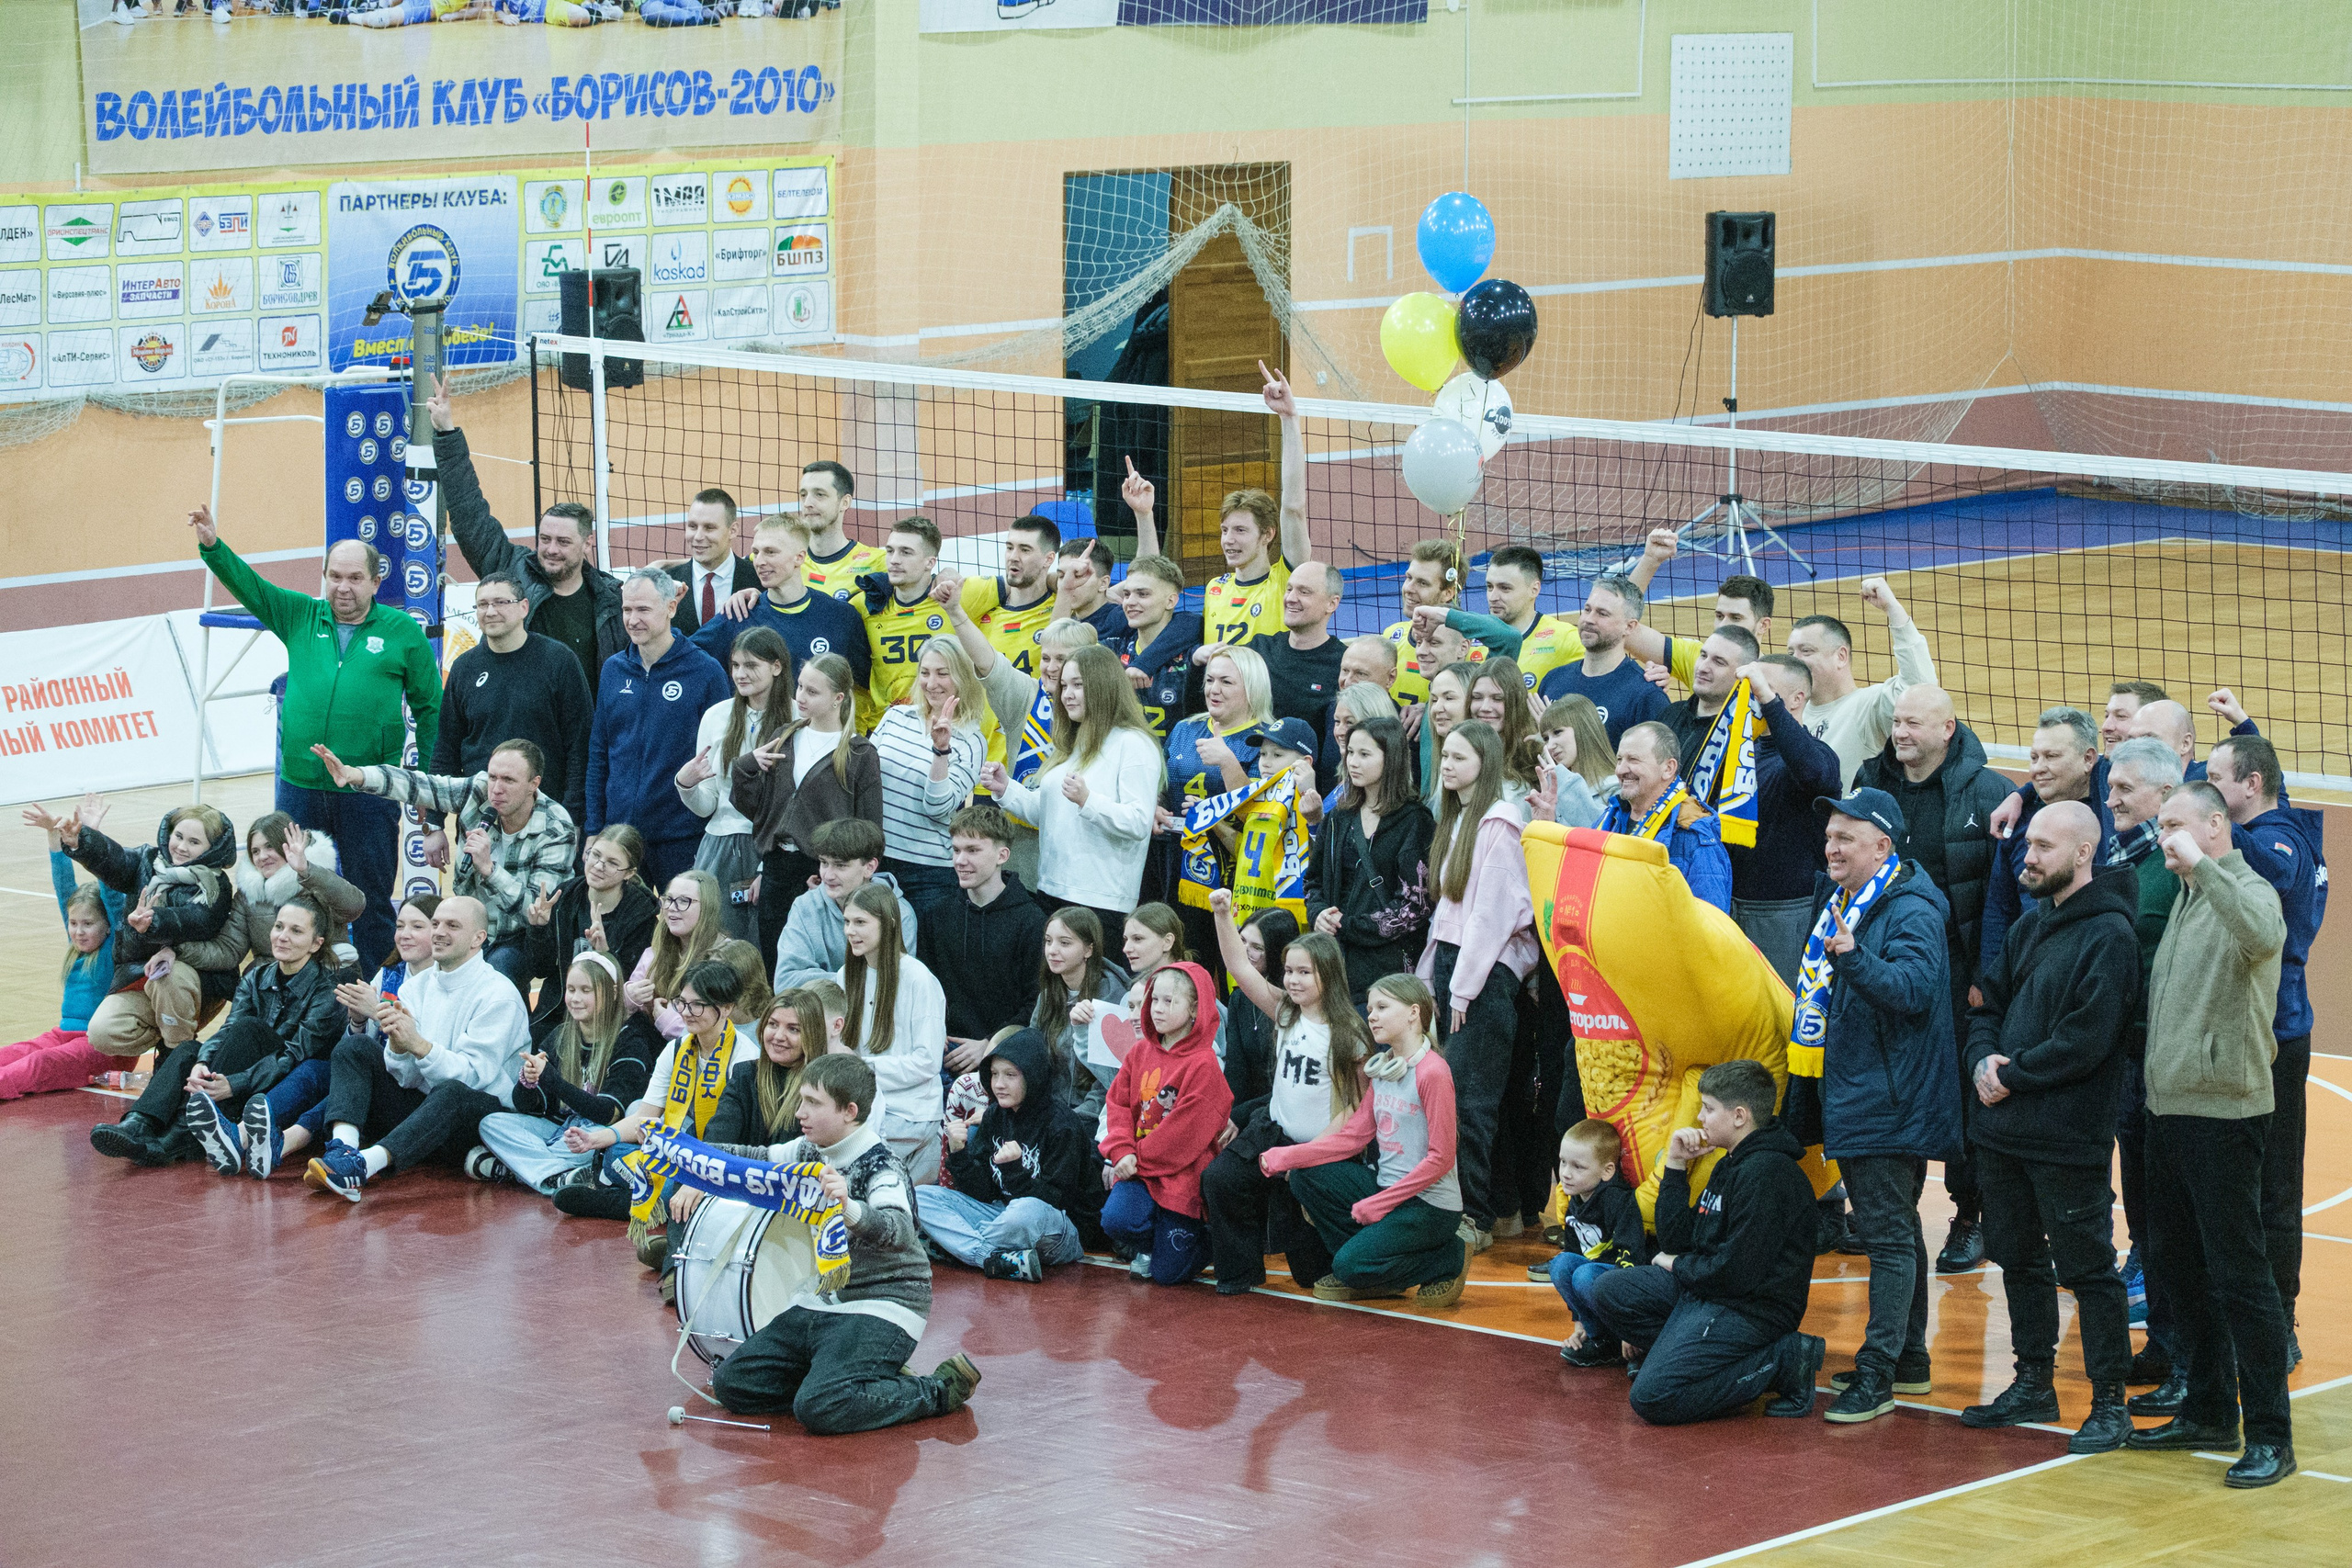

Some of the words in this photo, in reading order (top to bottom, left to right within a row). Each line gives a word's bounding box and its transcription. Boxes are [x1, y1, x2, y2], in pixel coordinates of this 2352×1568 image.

[96, 73, 420, 141] ВОЛЕЙБОЛЬНЫЙ
[432, 77, 528, 127] КЛУБ
[532, 64, 836, 123] «БОРИСОВ-2010»
[339, 193, 437, 212] ПАРТНЕРЫ
[443, 188, 507, 208] КЛУБА:
[715, 248, 767, 262] «Брифторг»
[776, 251, 824, 266] БШПЗ
[263, 350, 316, 360] ТЕХНОНИКОЛЬ
[1216, 621, 1249, 645] 12
[880, 634, 933, 664] 30
[1, 666, 133, 713] РАЙОННЫЙ
[50, 710, 159, 750] КОМИТЕТ
[1283, 1048, 1322, 1087] ME
